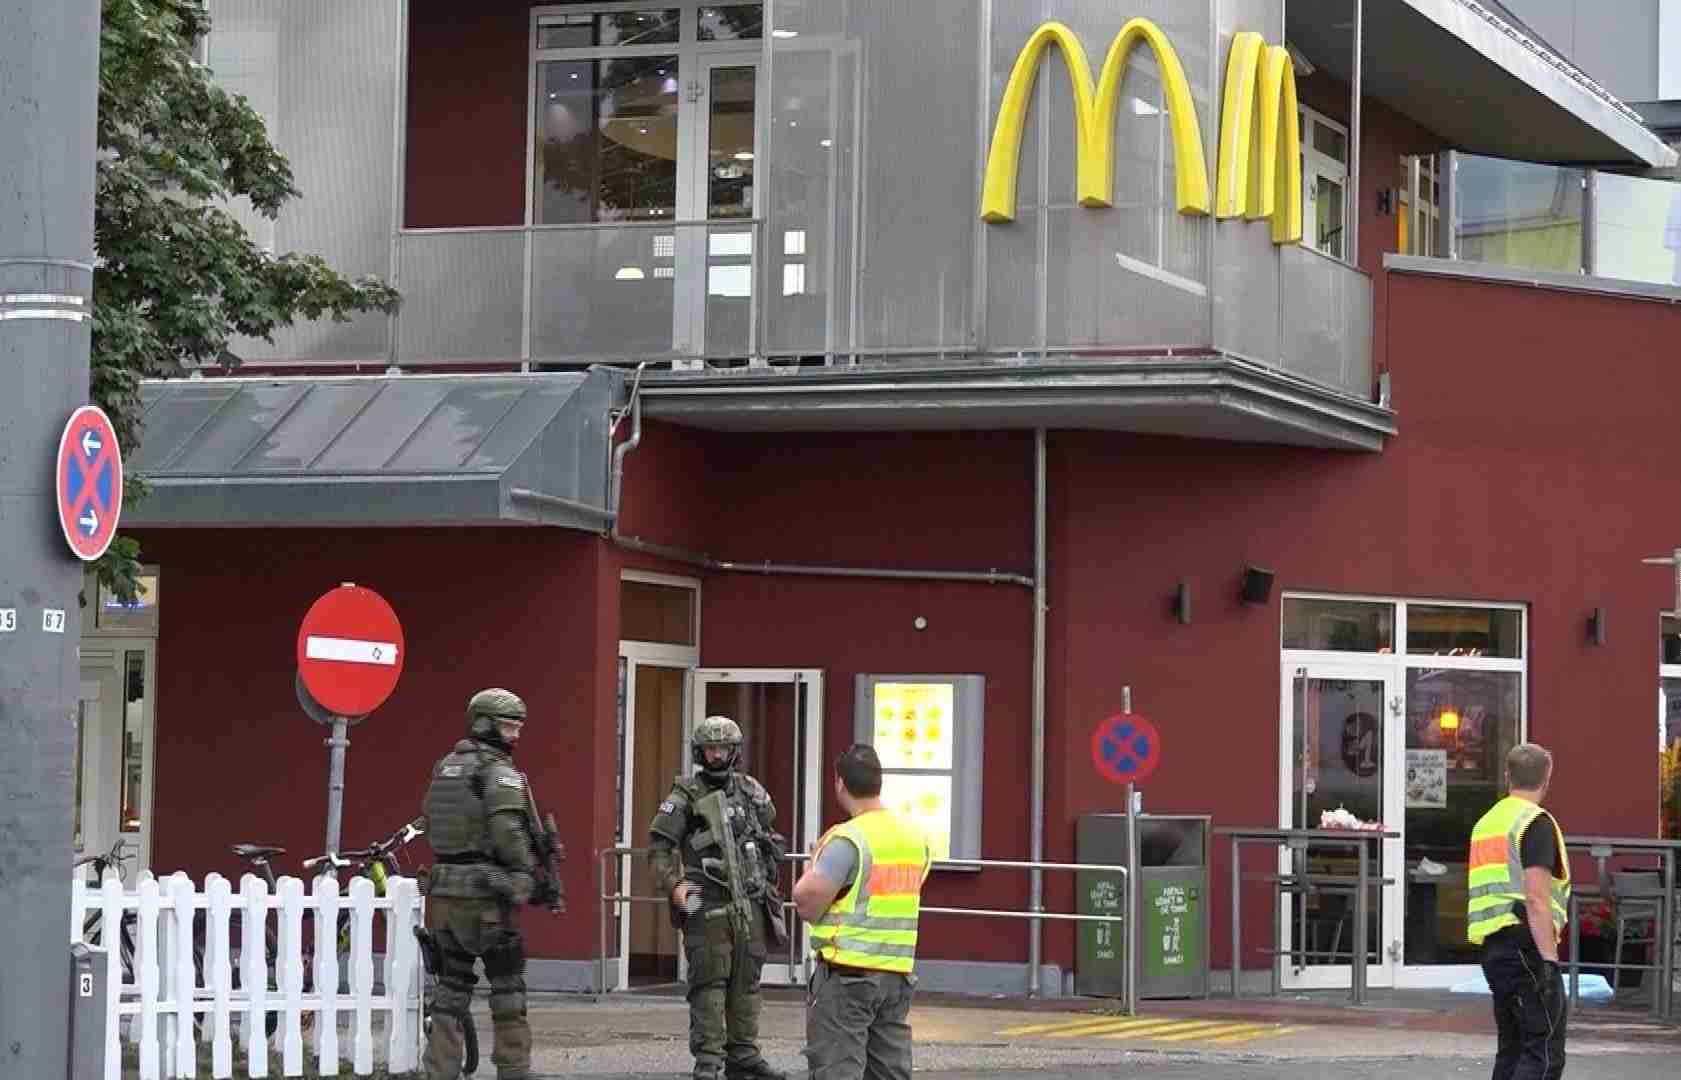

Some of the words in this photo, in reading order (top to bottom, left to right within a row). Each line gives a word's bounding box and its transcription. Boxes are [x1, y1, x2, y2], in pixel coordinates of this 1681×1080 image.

[0, 611, 14, 629] 5
[45, 613, 64, 629] 67
[82, 977, 91, 993] 3
